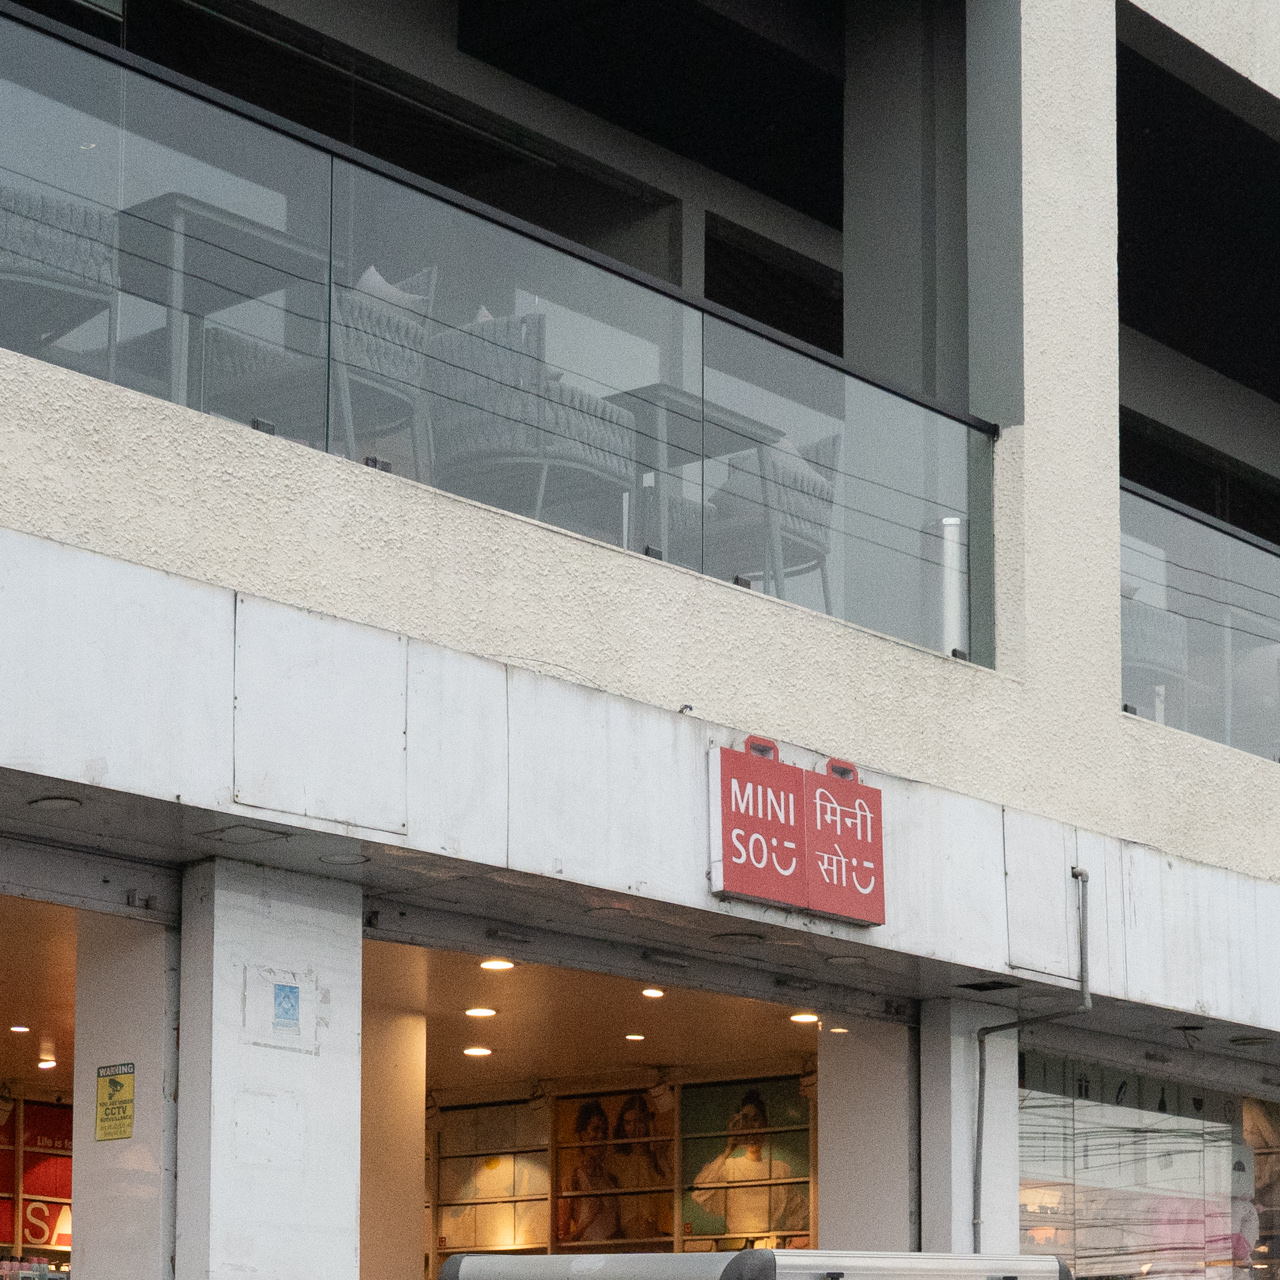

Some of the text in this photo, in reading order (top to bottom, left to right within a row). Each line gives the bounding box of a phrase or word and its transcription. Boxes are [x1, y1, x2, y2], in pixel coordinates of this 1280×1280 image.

[731, 778, 795, 827] MINI
[813, 788, 875, 843] मिनी
[99, 1064, 134, 1077] WARNING
[104, 1105, 127, 1117] CCTV
[24, 1201, 72, 1246] SA
